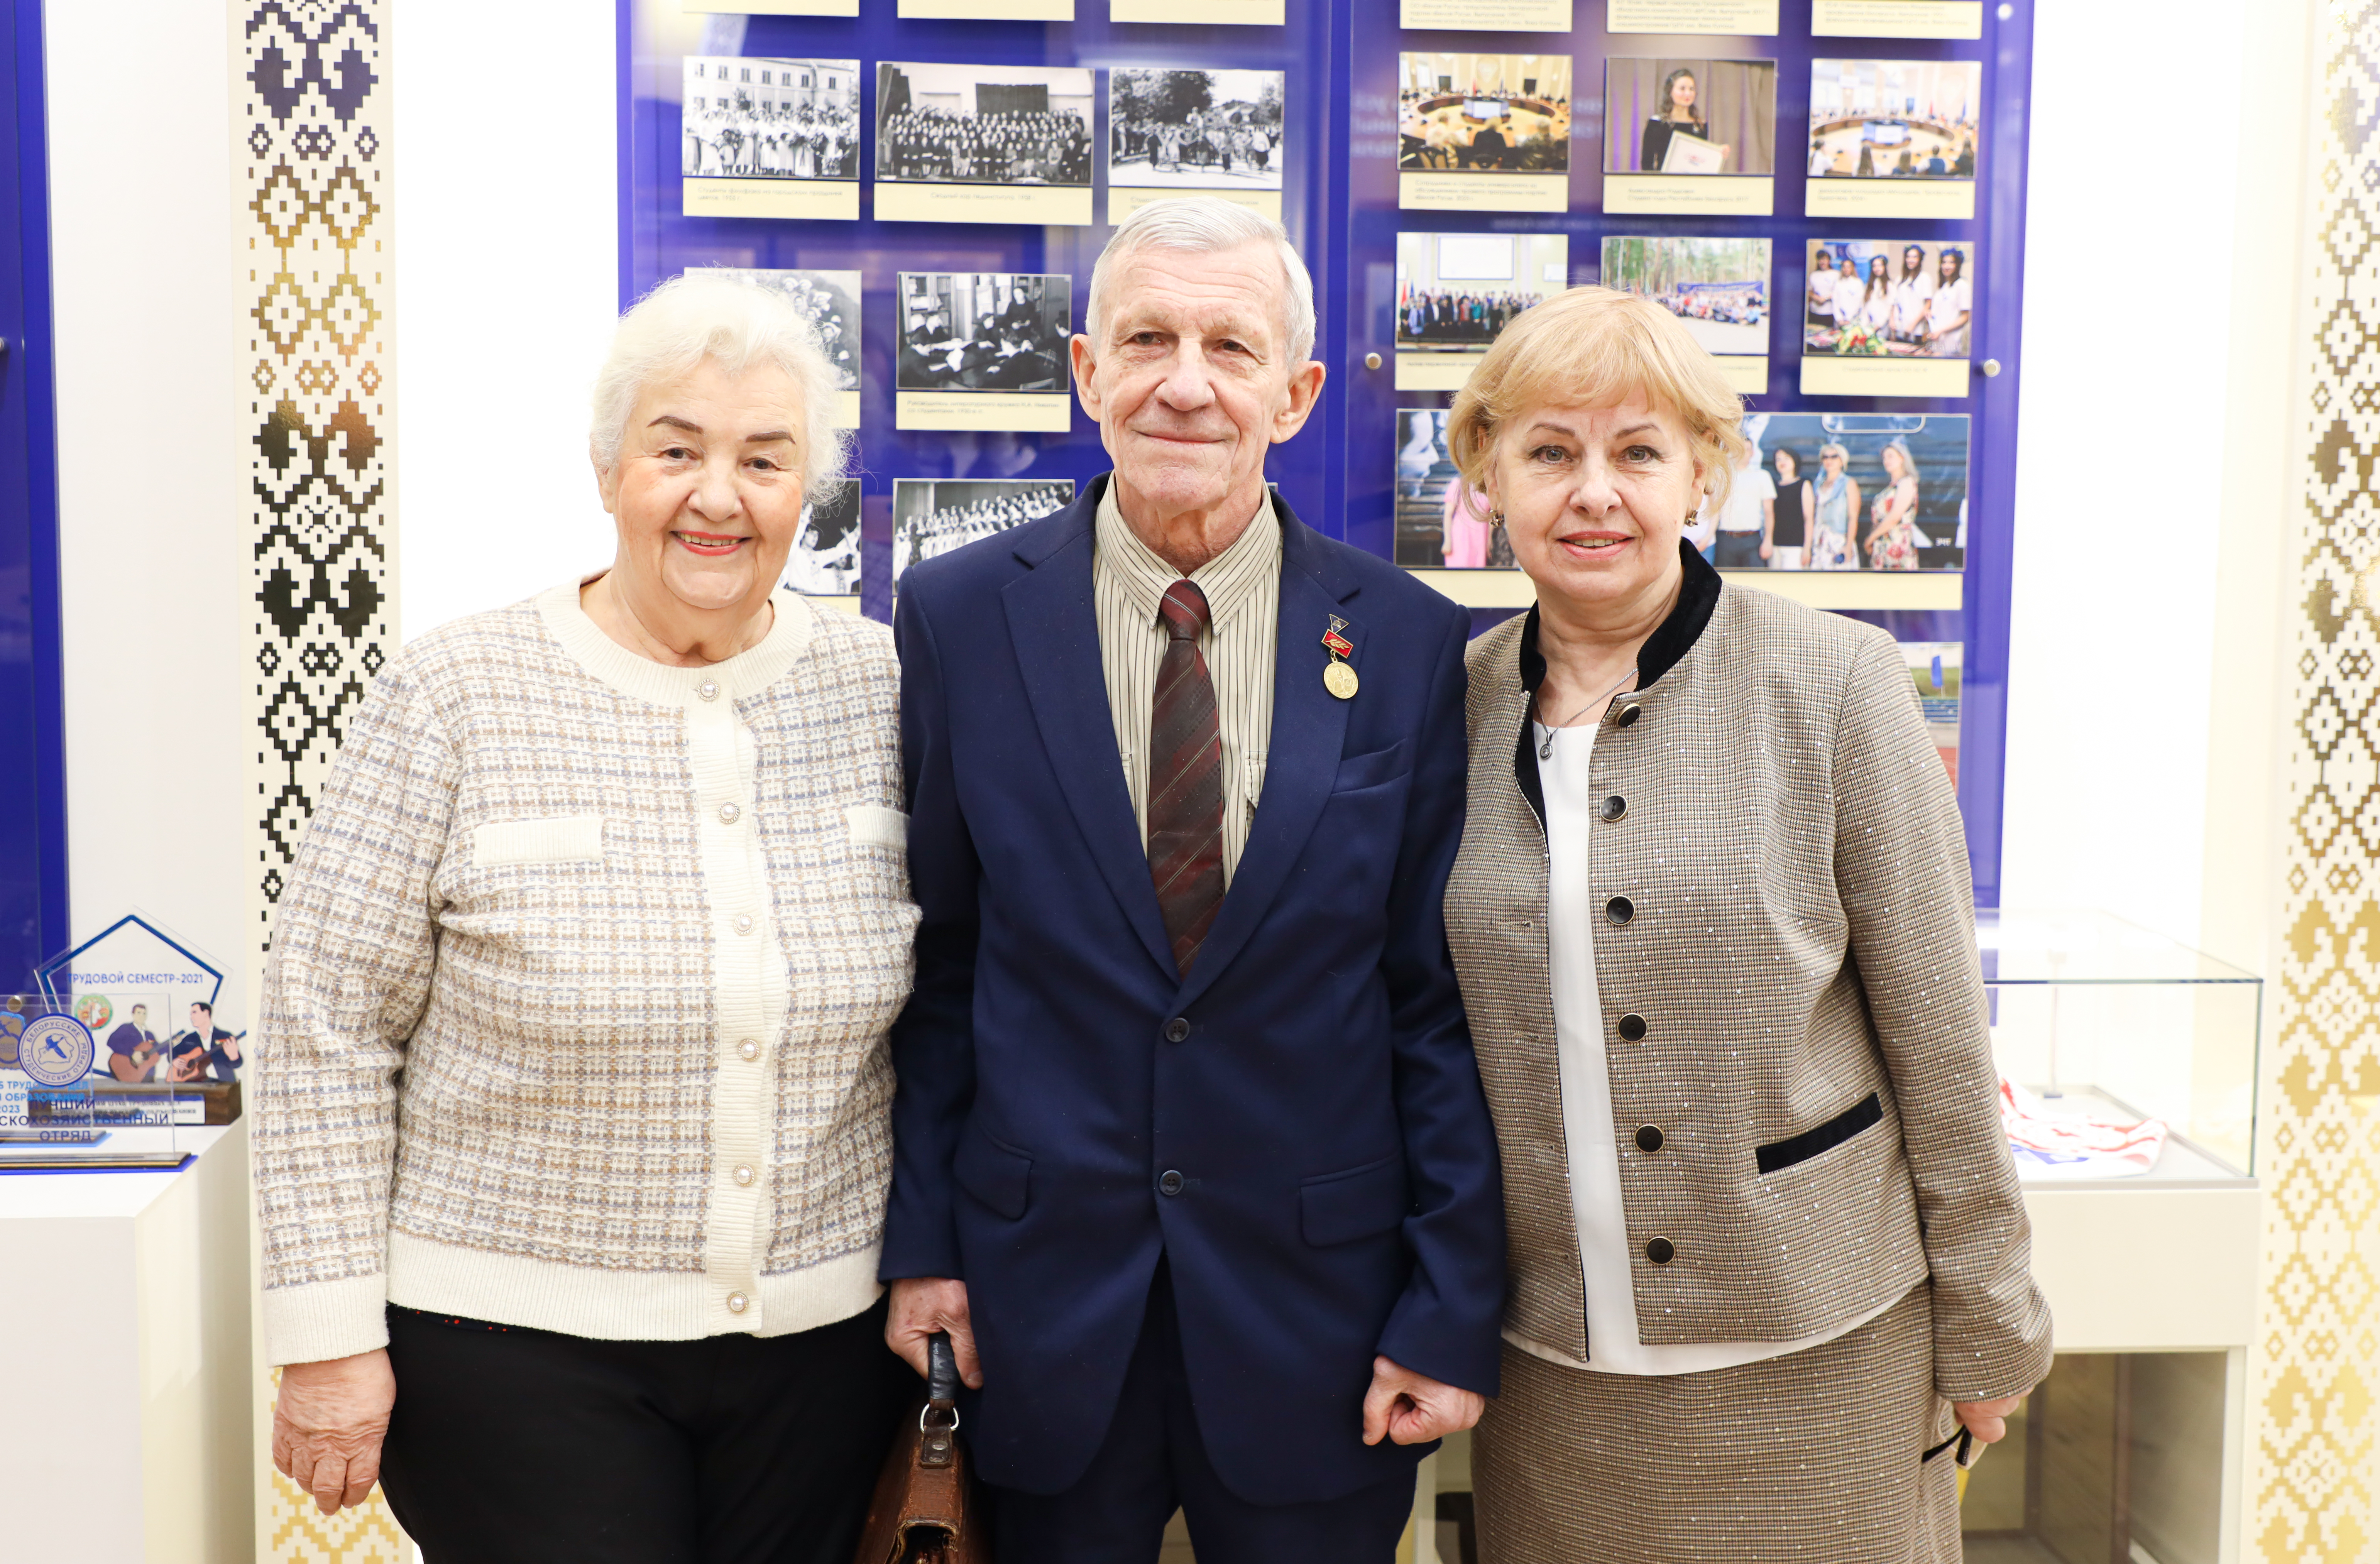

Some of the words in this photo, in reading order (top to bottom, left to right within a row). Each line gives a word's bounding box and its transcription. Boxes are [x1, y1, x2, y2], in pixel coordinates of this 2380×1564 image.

[68, 971, 124, 985] ТРУДОВОЙ
[127, 974, 203, 983] СЕМЕСТР-2021
[27, 1021, 80, 1042] БЕЛОРУССКИЕ
[24, 1049, 71, 1080] СТУДЕНЧЕСКИЕ
[73, 1043, 88, 1072] ОТРЯДЫ
[0, 1105, 20, 1113] 023
[40, 1131, 92, 1143] ОТРЯД
